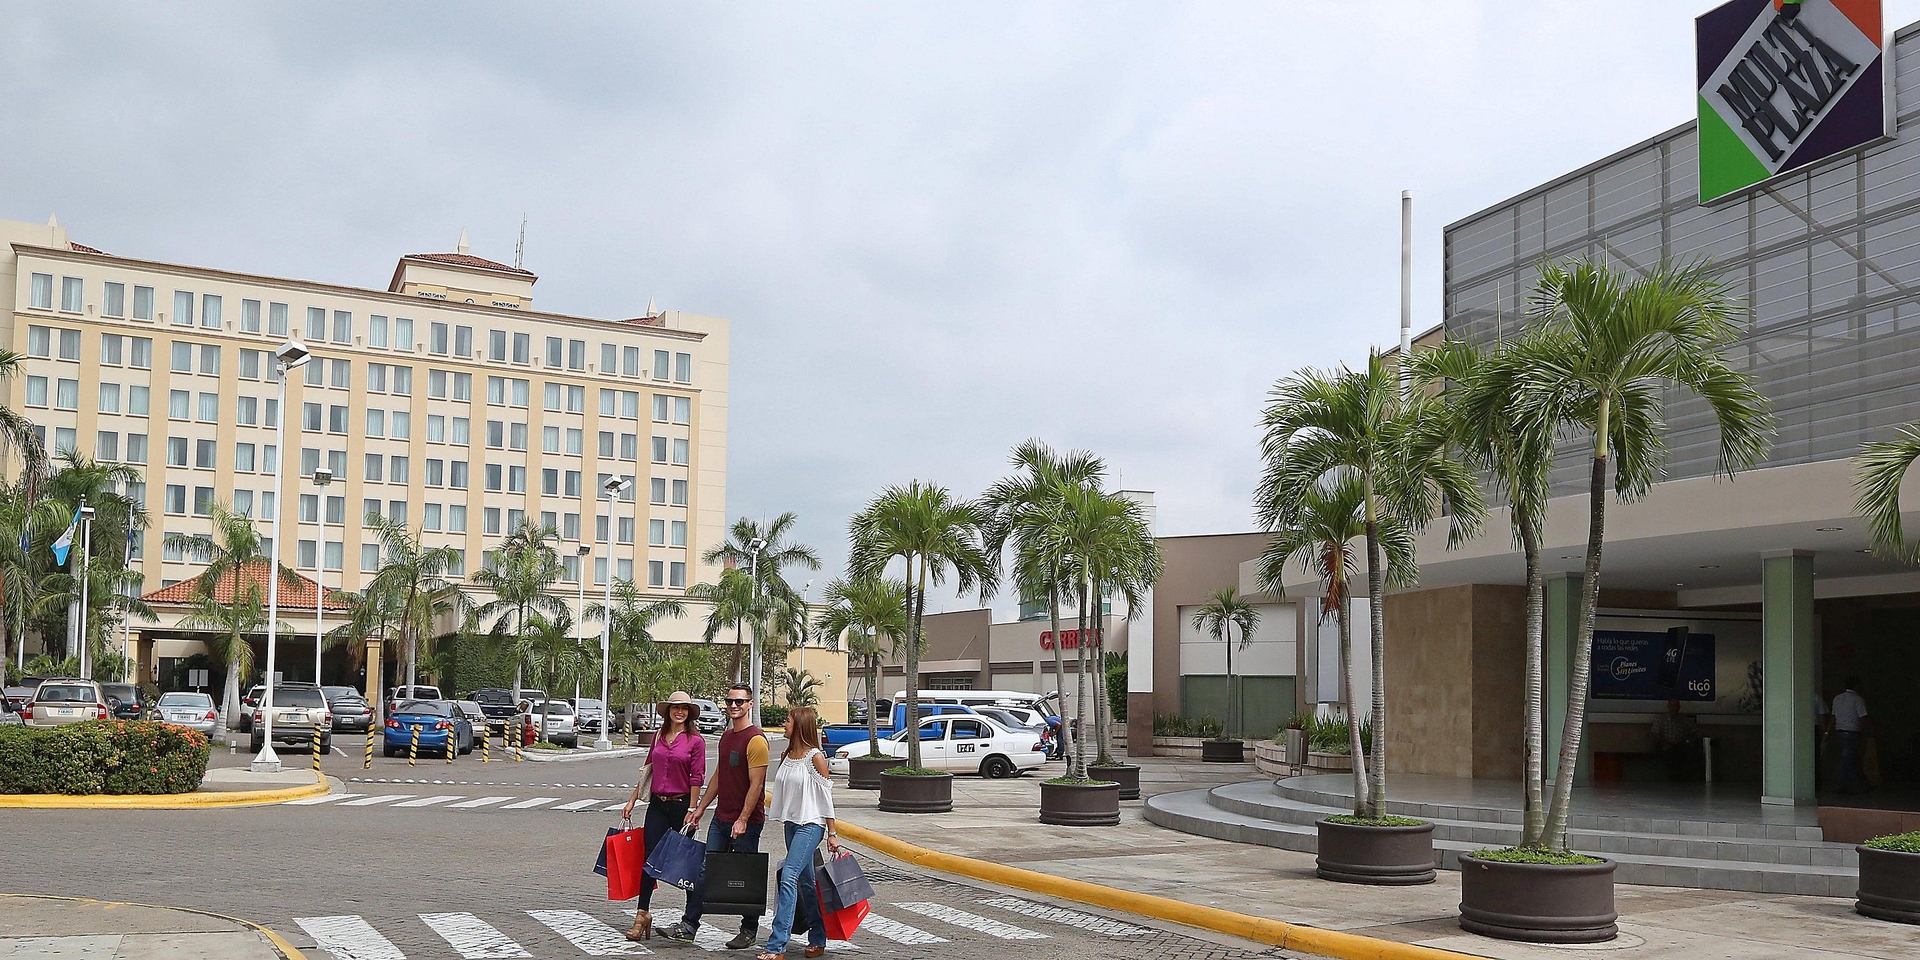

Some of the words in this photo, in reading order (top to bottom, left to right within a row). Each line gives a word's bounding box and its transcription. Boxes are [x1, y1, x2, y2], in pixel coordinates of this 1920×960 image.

[1716, 14, 1815, 127] MULTI
[1741, 36, 1861, 163] PLAZA
[1666, 648, 1678, 657] 4G
